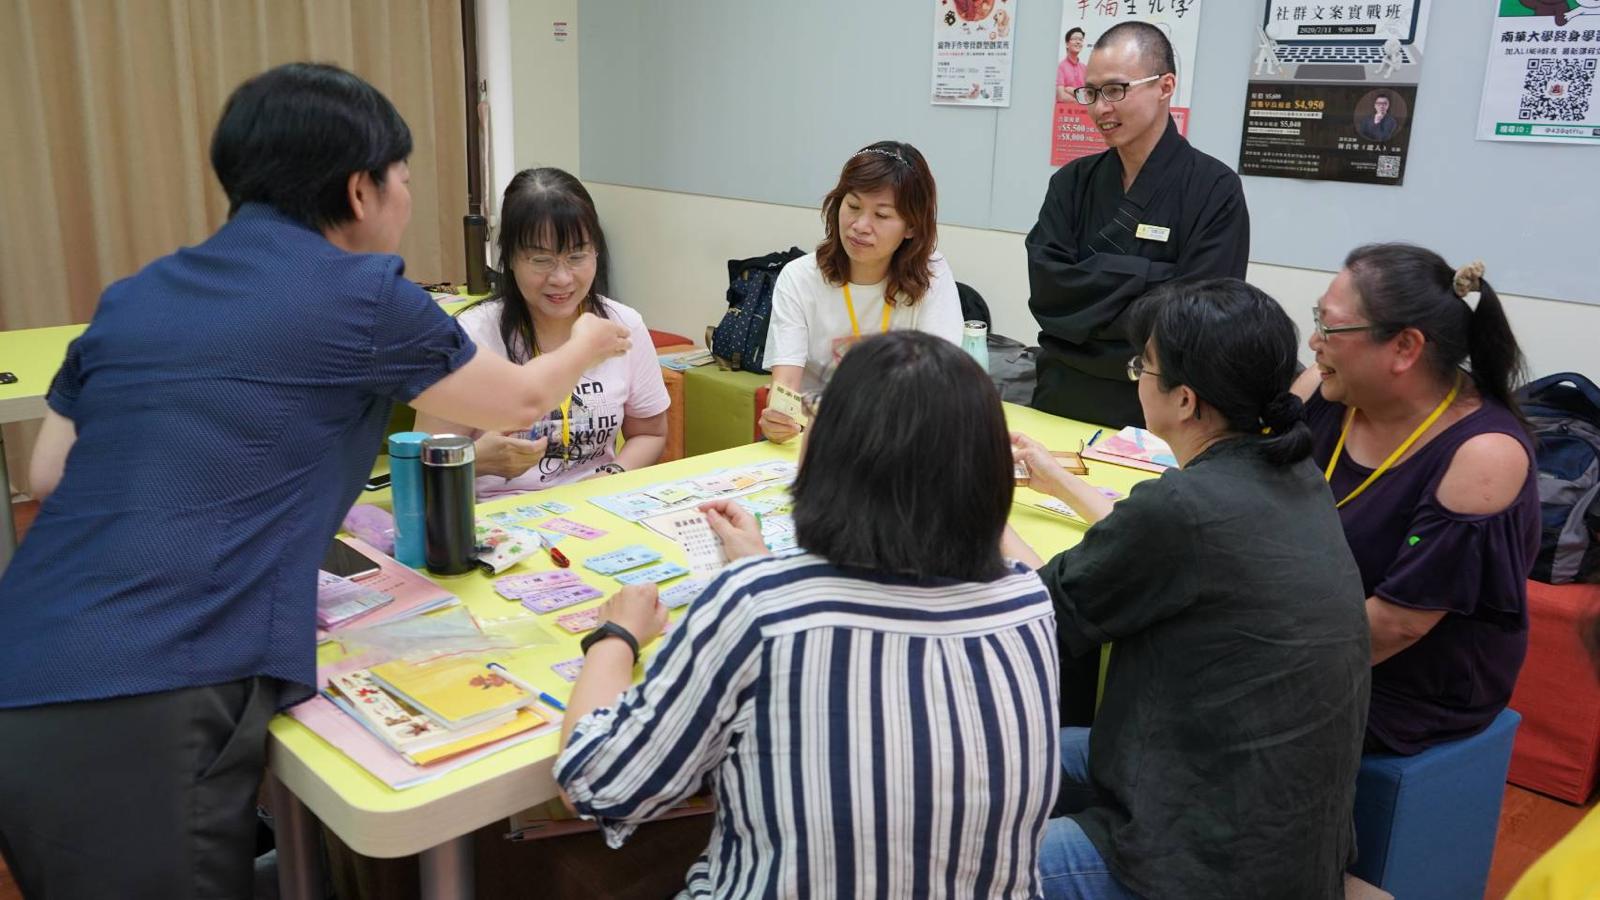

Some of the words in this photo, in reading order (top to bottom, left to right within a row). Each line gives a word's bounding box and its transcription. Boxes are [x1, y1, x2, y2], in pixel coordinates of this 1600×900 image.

[1276, 4, 1402, 21] 社群文案實戰班
[1299, 26, 1332, 34] 2020/7/11
[1294, 99, 1325, 110] $4,950
[596, 428, 614, 445] OF
